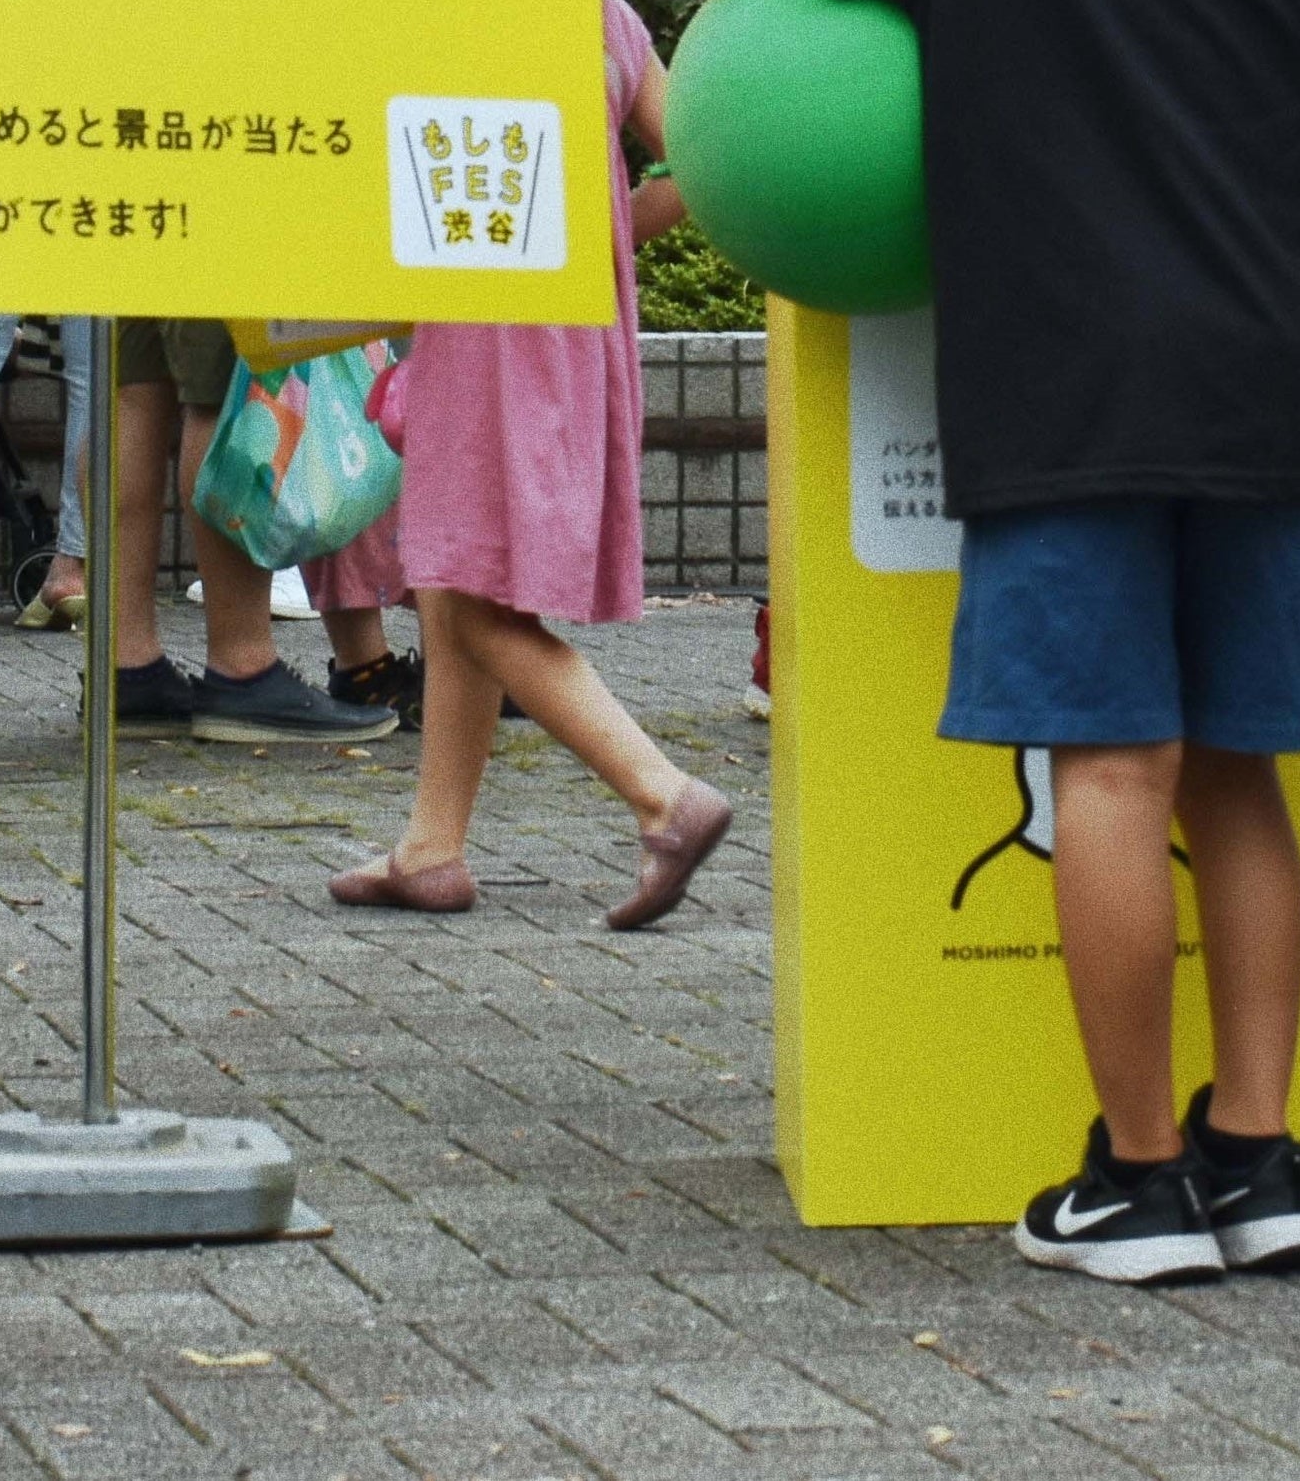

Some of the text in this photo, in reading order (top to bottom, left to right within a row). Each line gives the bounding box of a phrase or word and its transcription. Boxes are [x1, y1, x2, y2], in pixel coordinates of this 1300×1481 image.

[420, 116, 530, 164] もしも
[429, 164, 524, 205] FES
[442, 209, 515, 245] 渋谷
[941, 943, 1038, 962] MOSHIMO
